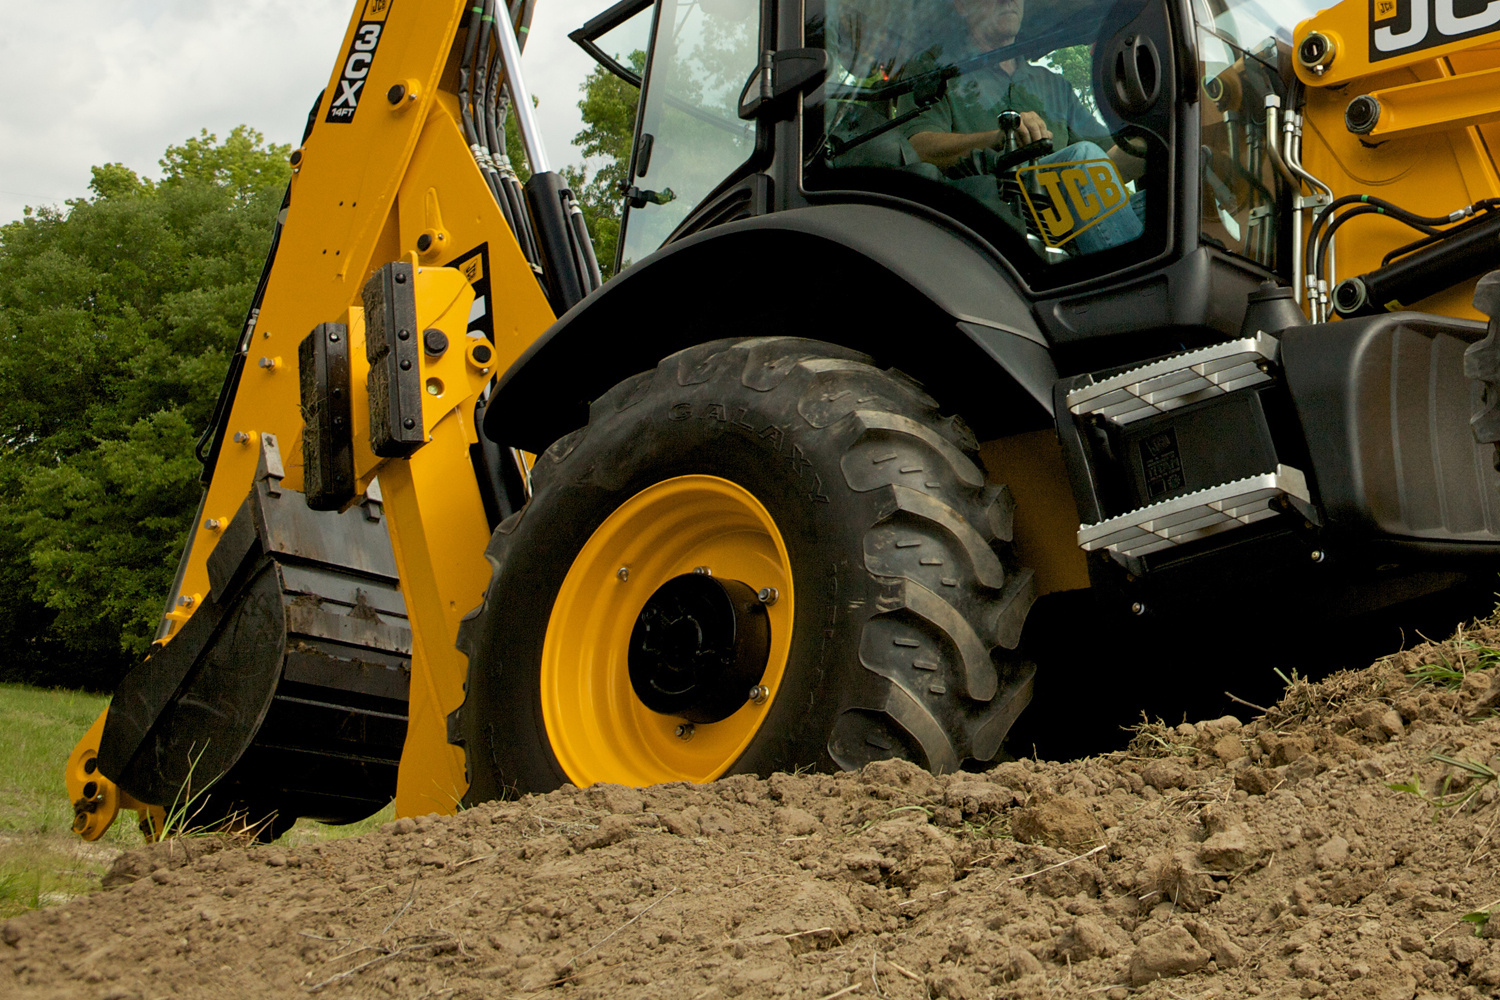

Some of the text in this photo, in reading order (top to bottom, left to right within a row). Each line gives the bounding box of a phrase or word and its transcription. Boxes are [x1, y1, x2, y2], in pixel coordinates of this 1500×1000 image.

[332, 24, 382, 107] 3CX
[1036, 165, 1121, 237] JCB
[668, 402, 830, 504] GALAXY
